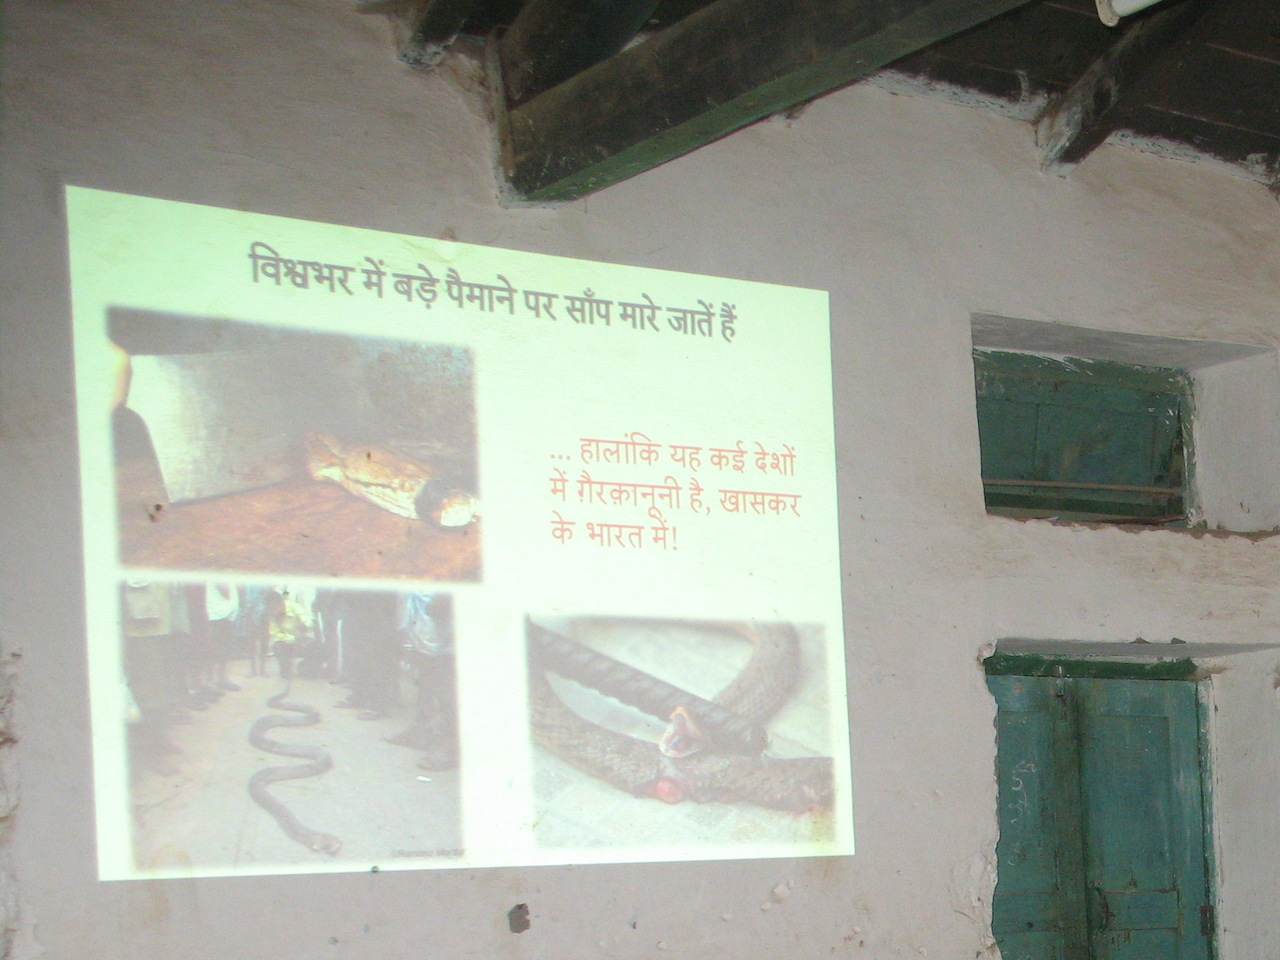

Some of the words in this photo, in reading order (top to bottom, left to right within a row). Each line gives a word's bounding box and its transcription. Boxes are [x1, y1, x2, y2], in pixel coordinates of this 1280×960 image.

[362, 257, 387, 298] में
[392, 264, 439, 309] बड़े
[445, 268, 517, 314] पैमाने
[523, 290, 559, 321] पर
[564, 288, 613, 326] साँप
[618, 293, 662, 332] मारे
[666, 299, 715, 337] जातें
[720, 302, 737, 343] हैं
[580, 432, 662, 465] हालांकि
[669, 445, 702, 472] यह
[709, 440, 748, 473] कई
[754, 442, 796, 476] देशों
[549, 468, 569, 501] में
[689, 477, 710, 515] है,
[718, 490, 802, 517] खासकर
[551, 511, 576, 544] के
[586, 523, 644, 548] भारत
[651, 517, 677, 550] में!
